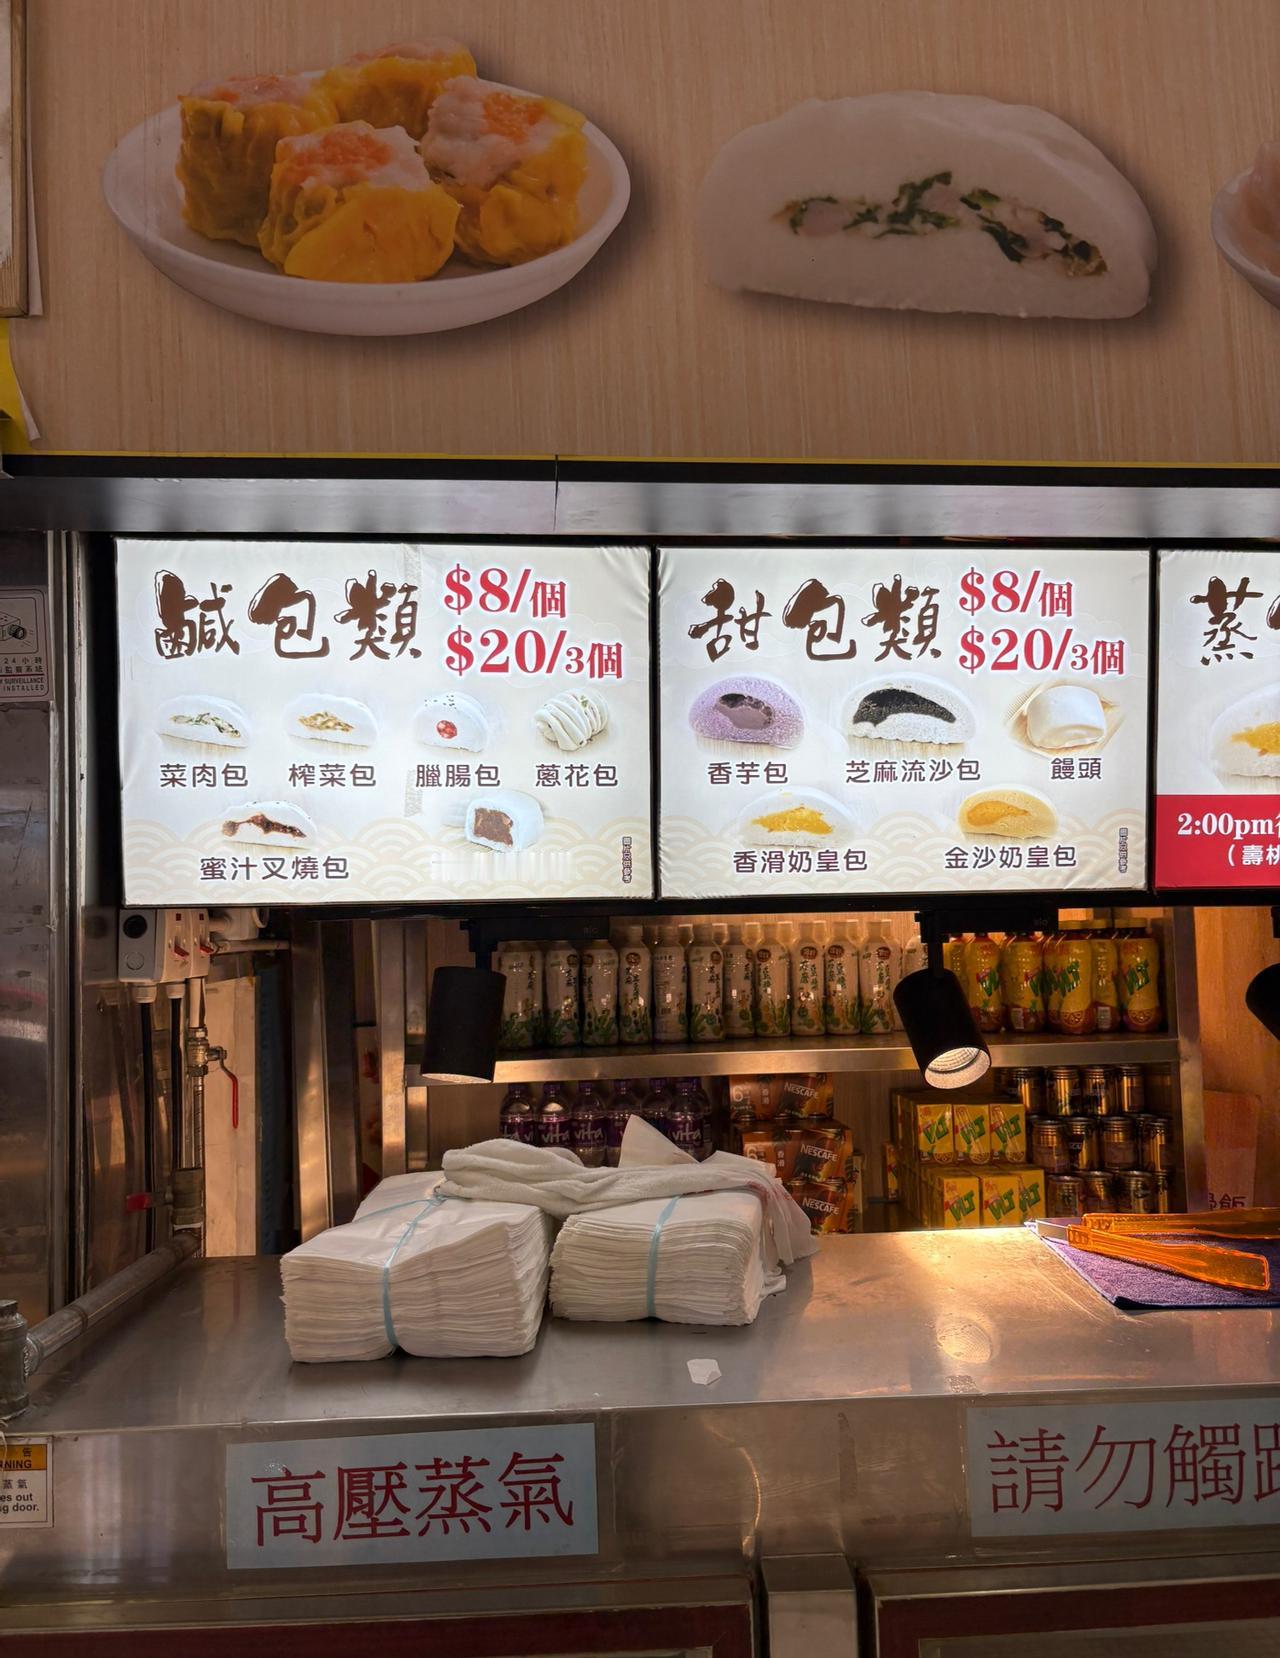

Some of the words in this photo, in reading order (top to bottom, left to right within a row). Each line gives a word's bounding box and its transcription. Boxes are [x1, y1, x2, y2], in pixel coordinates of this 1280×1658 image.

[445, 564, 567, 618] $8/個
[959, 570, 1072, 617] $8/個
[154, 568, 423, 661] 鹹包類
[688, 573, 943, 663] 甜包類
[1190, 576, 1280, 666] 蒸
[445, 625, 623, 680] $20/3個
[959, 626, 1125, 676] $20/3個
[3, 684, 44, 692] INSTALLED
[160, 763, 249, 788] 菜肉包
[288, 763, 377, 788] 榨菜包
[707, 762, 789, 785] 香芋包
[846, 759, 981, 783] 芝麻流沙包
[1050, 757, 1102, 781] 饅頭
[1177, 812, 1280, 840] 2:00pm
[200, 856, 350, 881] 蜜汁叉燒包
[733, 848, 868, 875] 香滑奶皇包
[944, 845, 1077, 870] 金沙奶皇包
[541, 1121, 570, 1143] vita
[574, 1121, 604, 1141] vita
[671, 1122, 702, 1141] vita
[0, 1460, 32, 1469] NING
[3, 1479, 28, 1489] 蒸氣
[12, 1502, 39, 1512] door.
[15, 1493, 33, 1502] out
[251, 1451, 574, 1547] 高壓蒸氣
